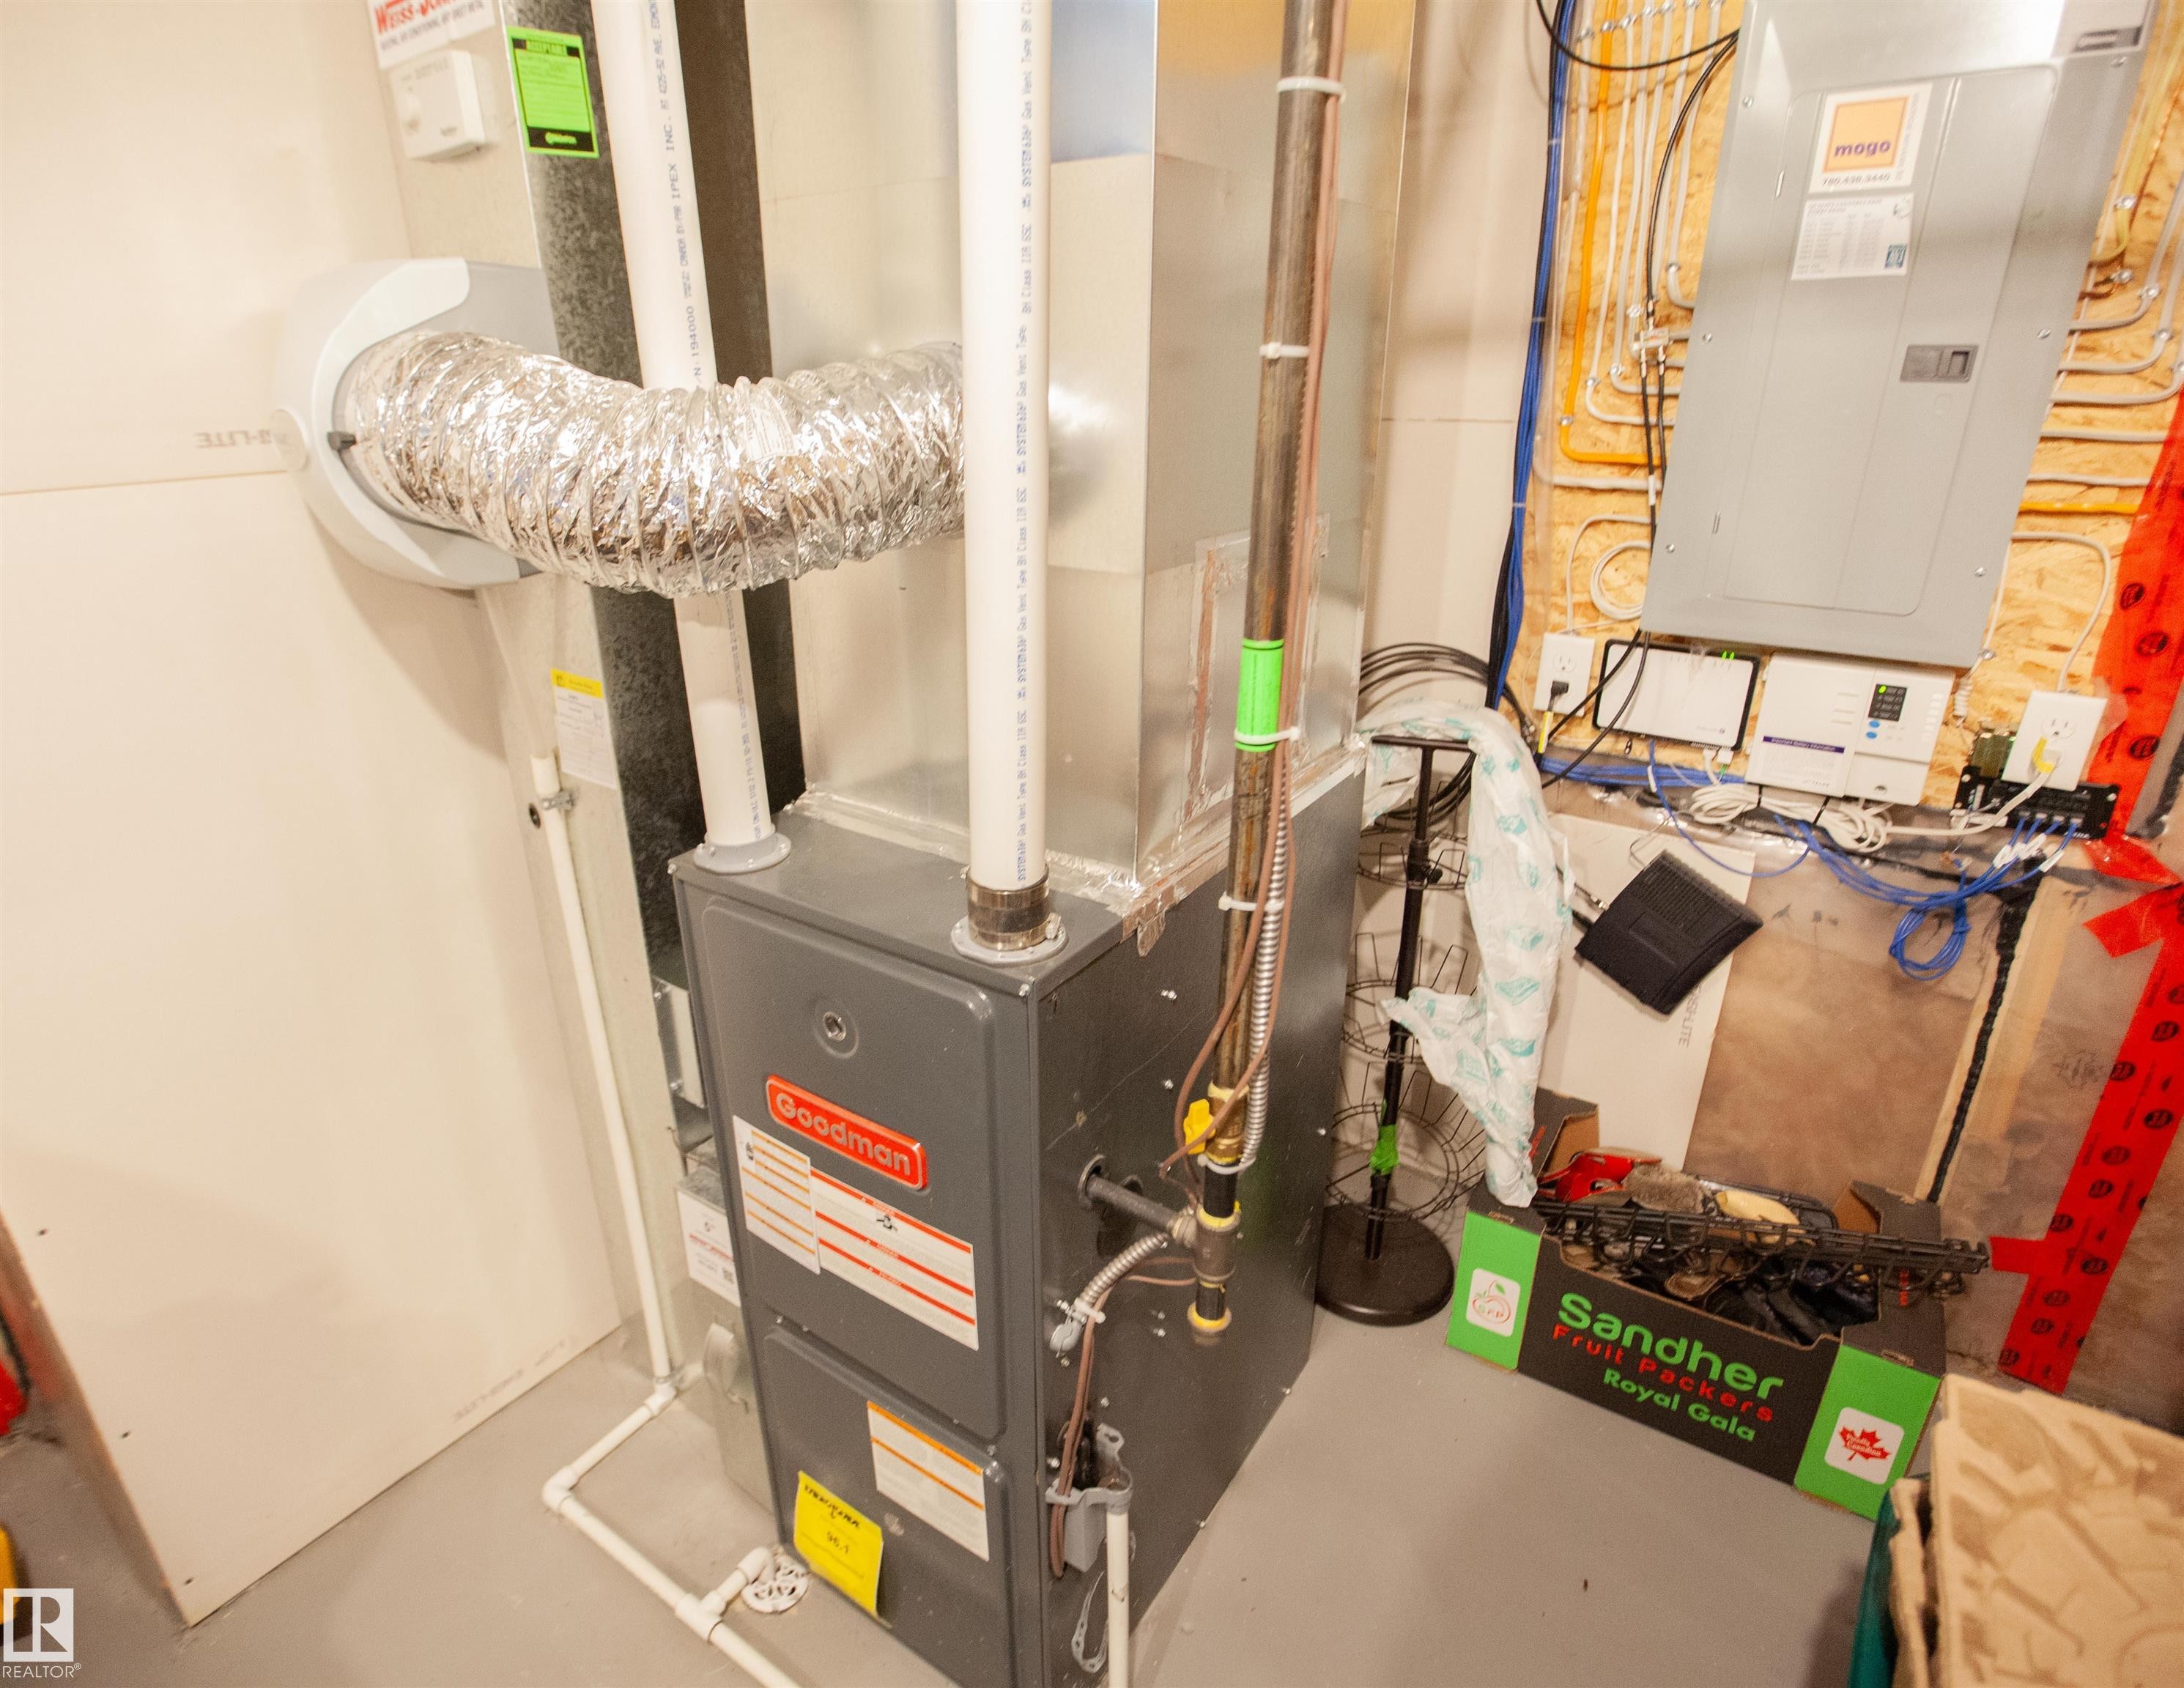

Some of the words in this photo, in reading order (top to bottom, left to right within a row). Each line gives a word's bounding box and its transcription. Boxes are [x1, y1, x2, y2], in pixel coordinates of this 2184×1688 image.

[663, 116, 675, 151] INC.
[1833, 139, 1891, 158] mogo
[668, 163, 681, 199] IPEX
[686, 306, 700, 357] 194000
[776, 1092, 911, 1177] Goodman
[1552, 1323, 1624, 1365] Fruit
[1637, 1357, 1774, 1423] Packers
[1558, 1292, 1783, 1399] Sandher
[1604, 1369, 1680, 1411] Royal
[1688, 1402, 1756, 1442] Gala
